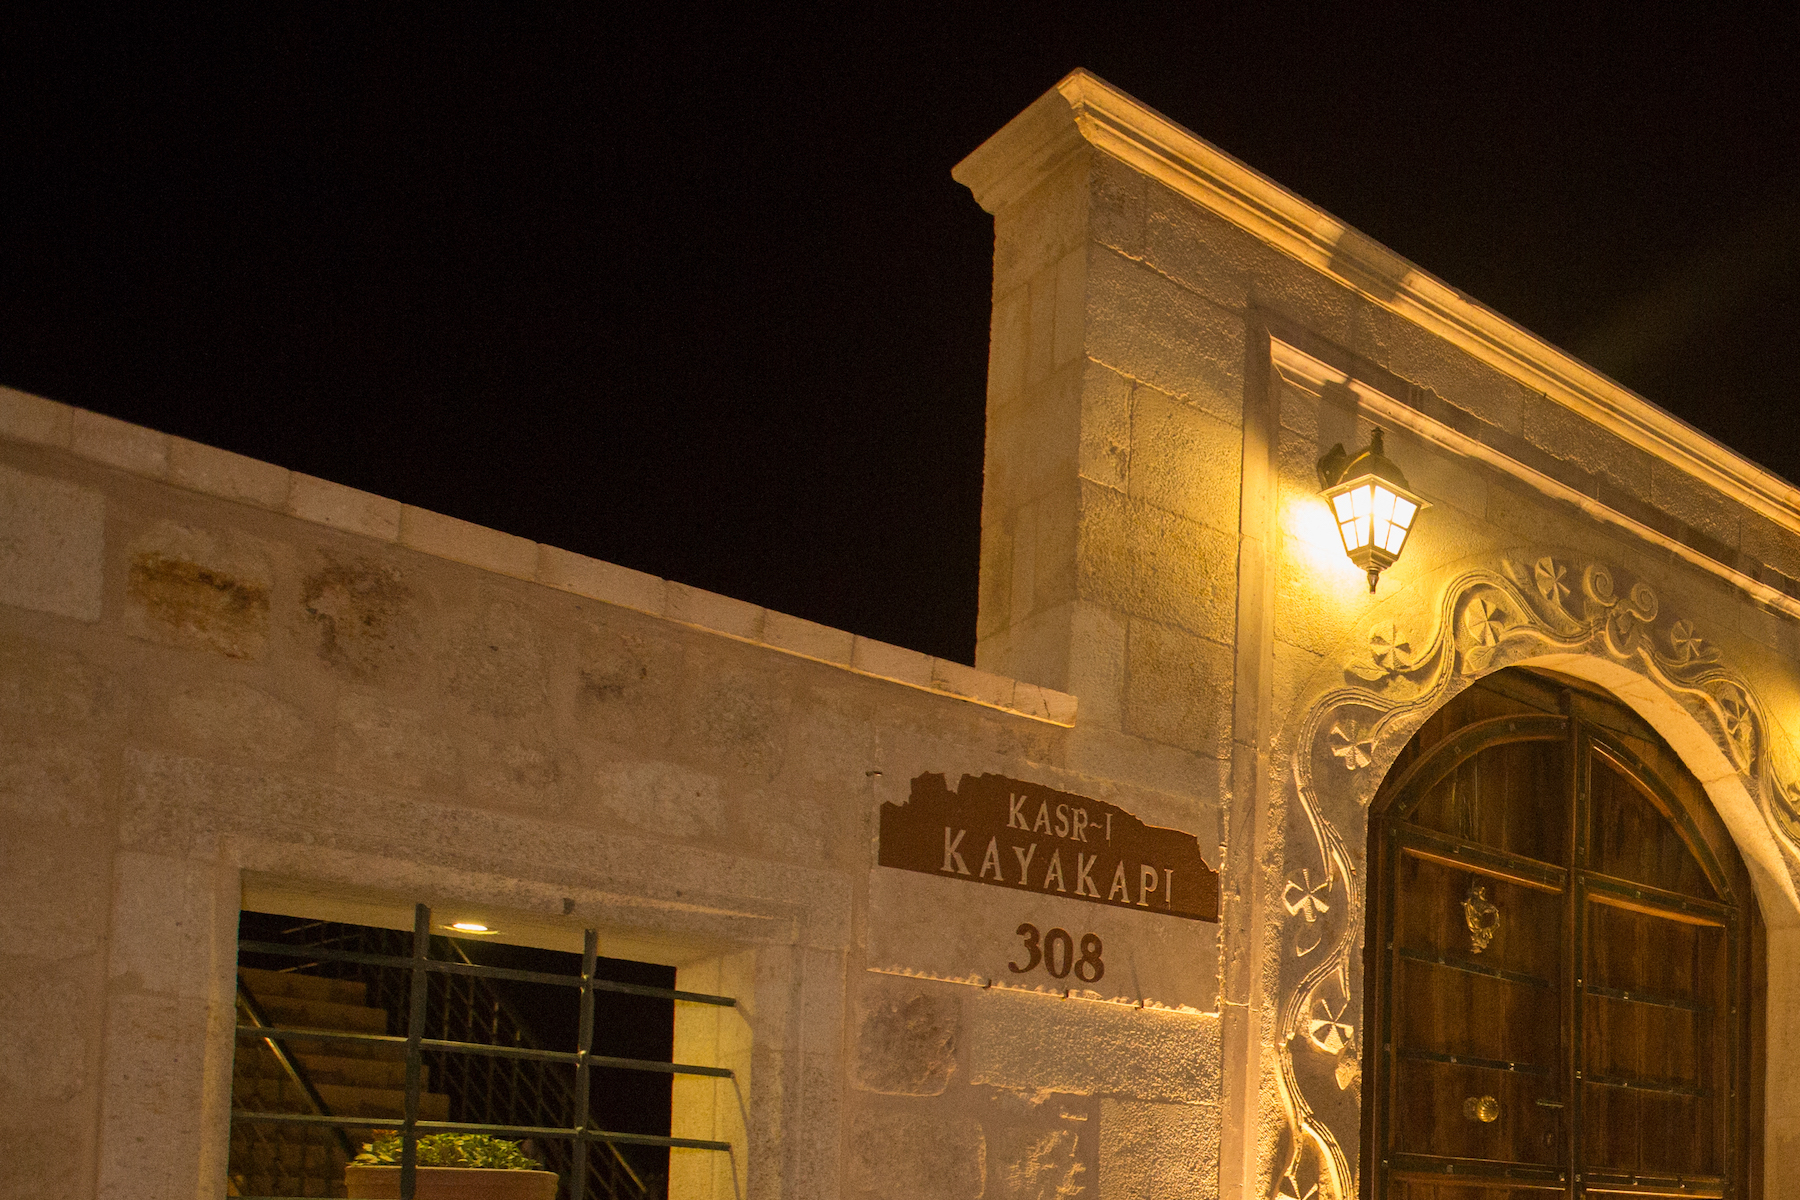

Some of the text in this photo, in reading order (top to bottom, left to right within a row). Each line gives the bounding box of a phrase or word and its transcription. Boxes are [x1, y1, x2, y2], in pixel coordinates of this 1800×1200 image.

[1006, 792, 1113, 844] KASR-I
[941, 826, 1174, 907] KAYAKAPI
[1008, 922, 1105, 983] 308
